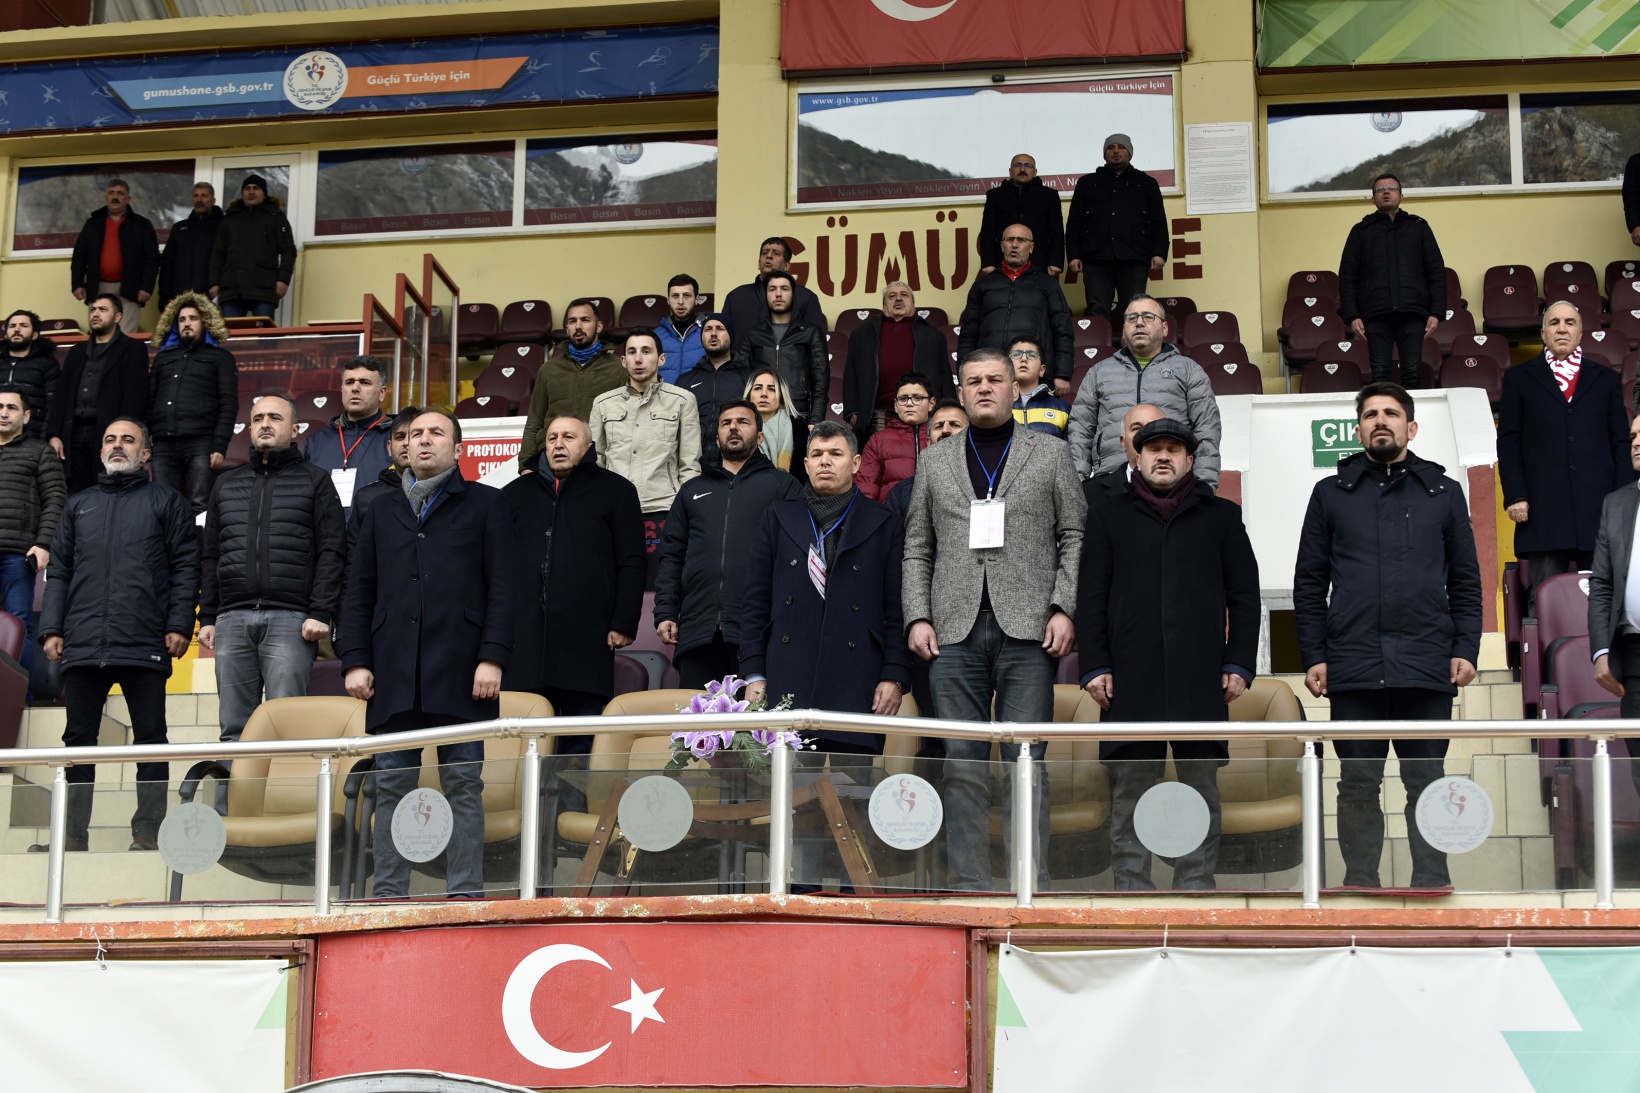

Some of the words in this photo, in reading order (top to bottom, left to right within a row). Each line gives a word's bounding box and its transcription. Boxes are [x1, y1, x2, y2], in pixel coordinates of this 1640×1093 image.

[367, 74, 401, 86] Güçlü
[403, 72, 447, 84] Türkiye
[449, 70, 471, 82] için
[143, 82, 274, 100] gumushane.gsb.gov.tr
[1088, 85, 1114, 93] Güçlü
[1116, 82, 1148, 91] Türkiye
[812, 95, 879, 105] www.gsb.gov.tr
[838, 188, 872, 197] Naklen
[875, 186, 903, 197] Yayın
[915, 184, 950, 194] Naklen
[952, 182, 980, 193] Yayın
[592, 209, 619, 219] Basın
[634, 207, 661, 217] Basın
[677, 205, 704, 215] Basın
[550, 211, 577, 221] Basın
[1319, 422, 1360, 447] ÇIK
